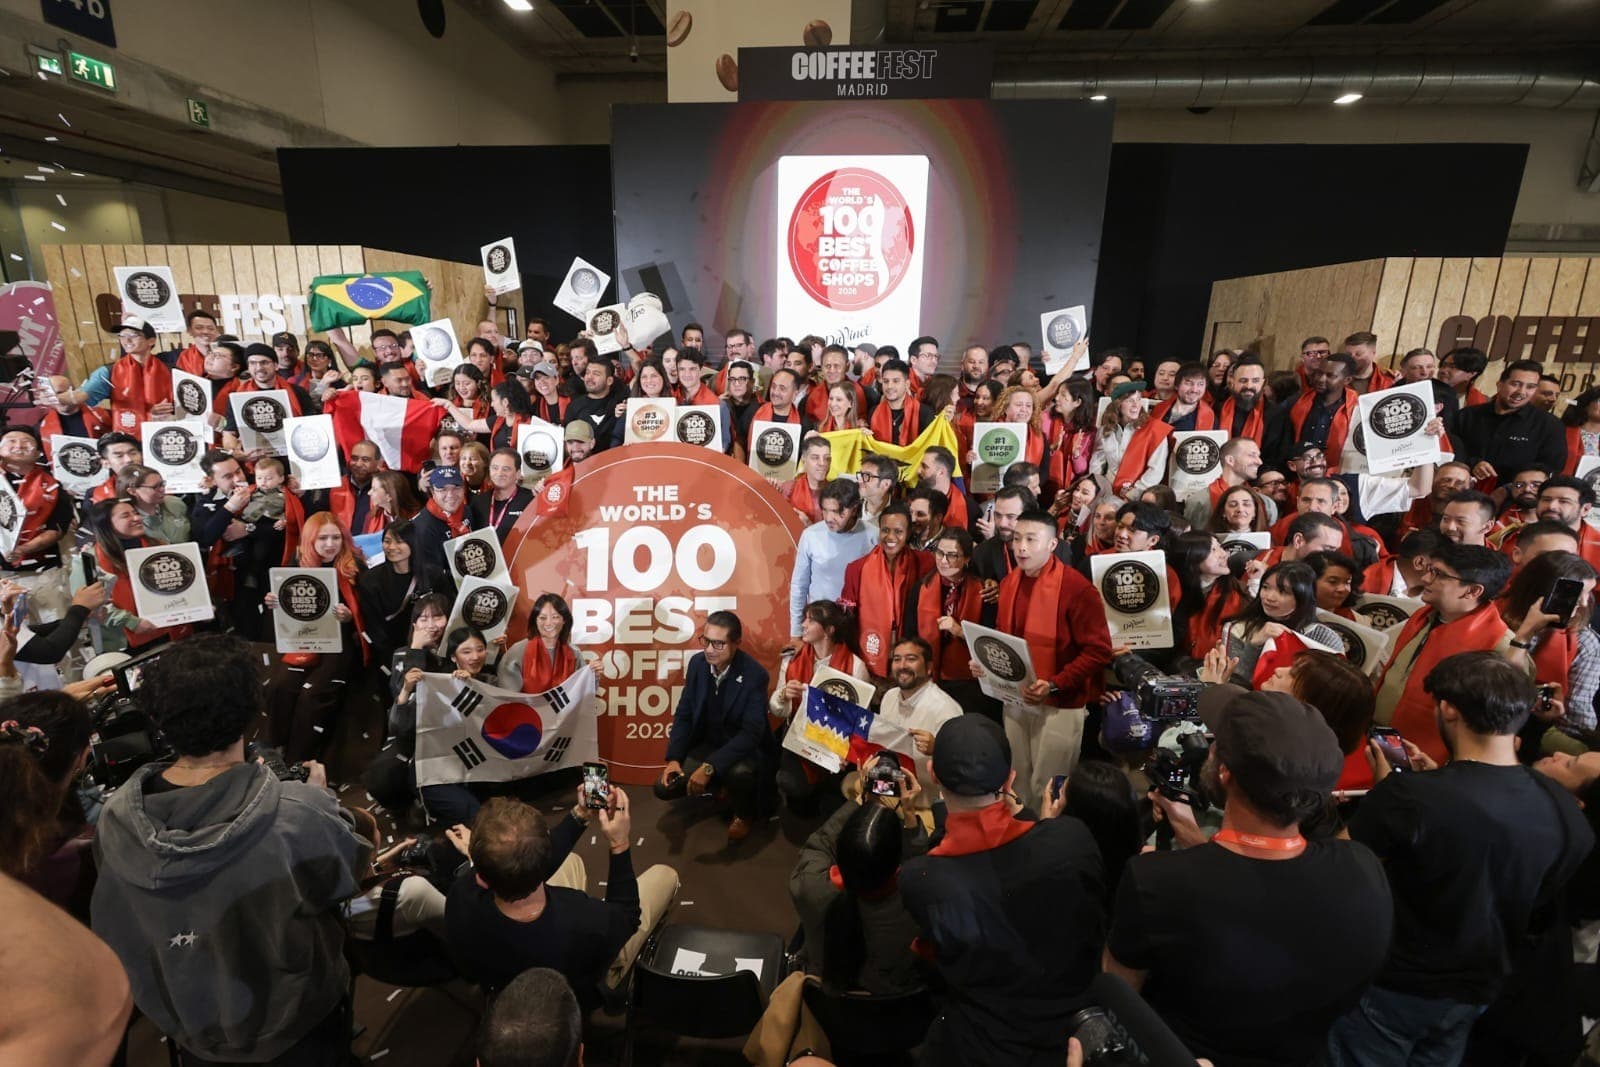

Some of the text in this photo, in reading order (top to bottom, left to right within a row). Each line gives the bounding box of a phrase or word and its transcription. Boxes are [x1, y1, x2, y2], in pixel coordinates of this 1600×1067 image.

[791, 50, 937, 80] COFFEEFEST
[837, 83, 888, 96] MADRID
[842, 187, 861, 196] THE
[819, 206, 877, 235] 100
[822, 273, 874, 286] SHOPS
[1054, 322, 1072, 331] 100
[250, 405, 274, 413] 100
[1383, 403, 1412, 417] 100
[1384, 412, 1412, 424] BEST
[686, 420, 706, 428] 100
[162, 436, 185, 444] 100
[766, 436, 785, 446] 100
[68, 450, 90, 459] 100
[1187, 445, 1209, 454] 100
[632, 485, 678, 502] THE
[462, 548, 483, 560] 100
[573, 524, 736, 592] 100
[152, 561, 181, 572] 100
[465, 556, 485, 566] BEST
[154, 570, 182, 580] BEST
[1115, 573, 1144, 585] 100
[290, 587, 316, 597] 100
[1116, 584, 1145, 594] BEST
[477, 596, 498, 608] 100
[474, 605, 496, 615] BEST
[572, 596, 737, 644] BEST
[984, 645, 1010, 660] 100
